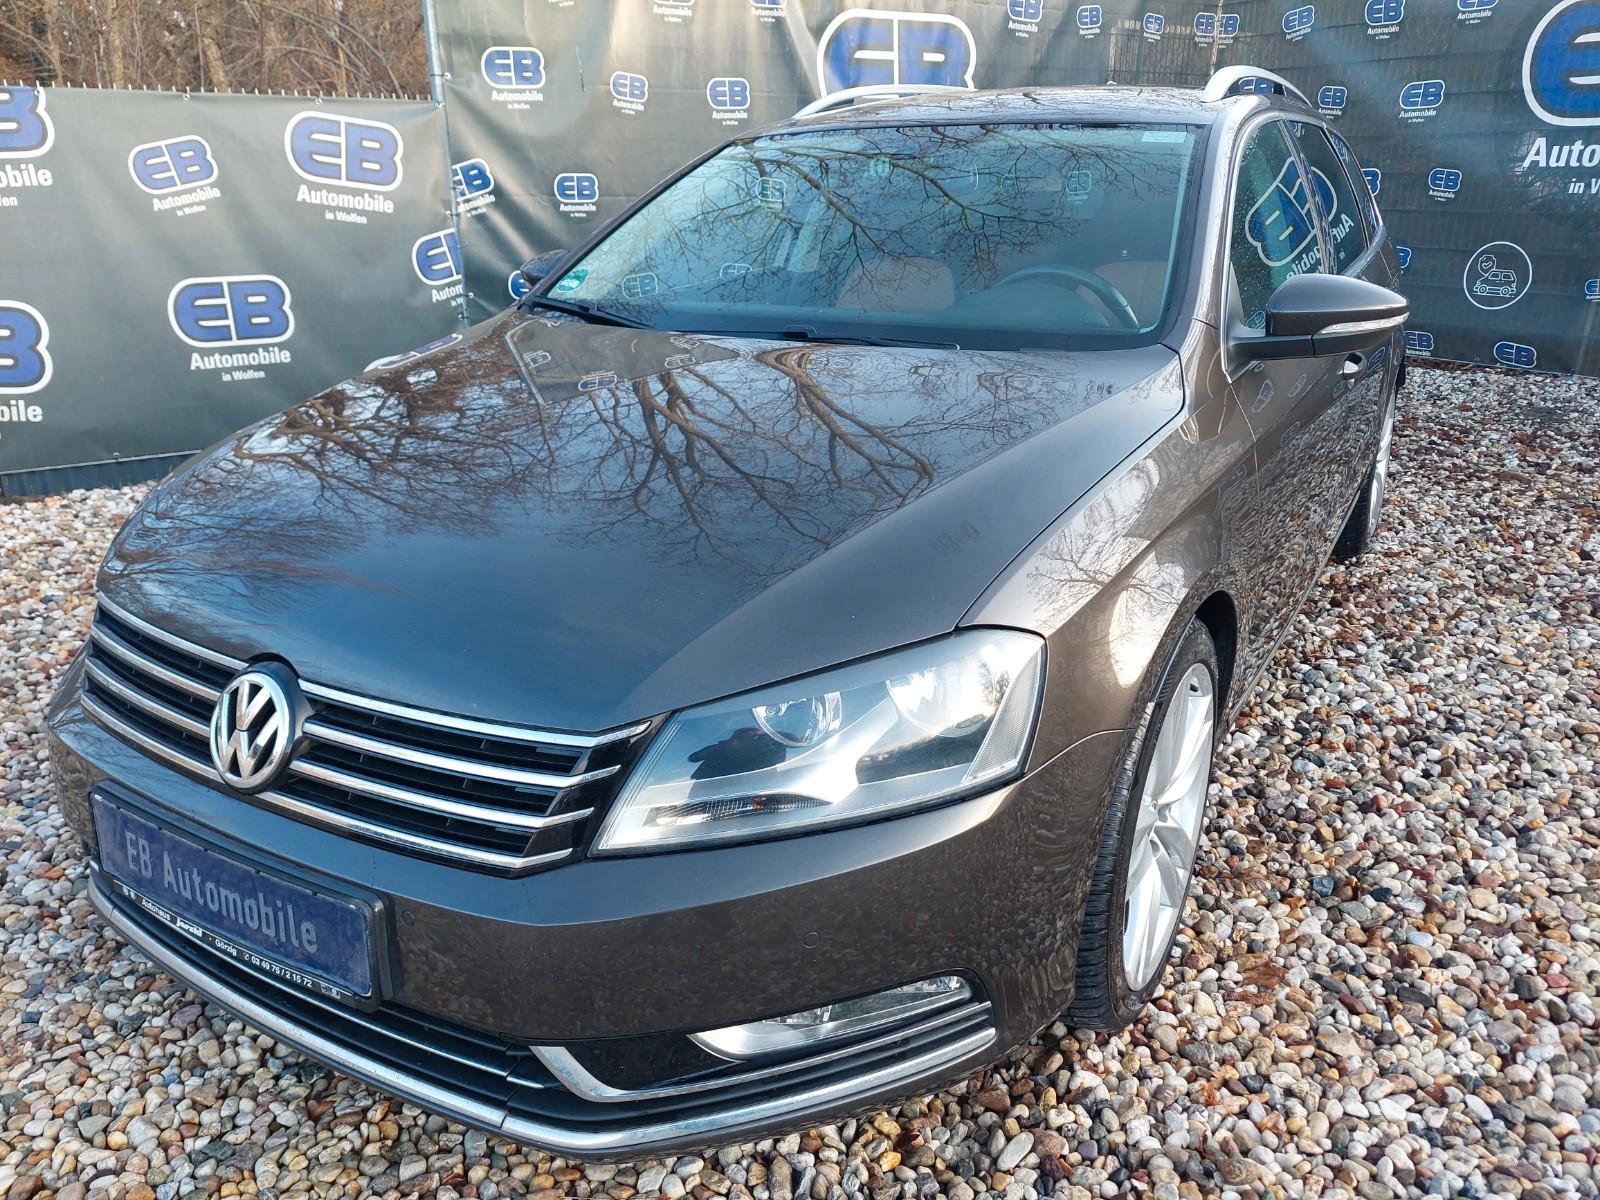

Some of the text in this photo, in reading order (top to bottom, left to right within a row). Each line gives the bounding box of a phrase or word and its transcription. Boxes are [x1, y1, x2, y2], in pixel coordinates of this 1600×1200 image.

[653, 5, 692, 17] Automobile
[752, 8, 786, 17] Automobile
[1076, 5, 1102, 29] EB
[1282, 5, 1314, 33] EB
[1365, 0, 1404, 26] EB
[1457, 9, 1493, 20] Automobile
[1008, 21, 1039, 33] Automobile
[1367, 25, 1400, 35] Automobile
[481, 47, 546, 89] EB
[491, 90, 543, 102] Automobile
[610, 71, 648, 102] EB
[707, 77, 750, 110] EB
[1318, 85, 1348, 108] EB
[1399, 79, 1446, 110] EB
[612, 98, 644, 112] Automobile
[712, 110, 748, 120] Automobile
[1399, 108, 1437, 119] Automobile
[284, 110, 404, 192] EB
[128, 134, 219, 195] EB
[554, 173, 599, 203] EB
[1428, 167, 1462, 191] EB
[1568, 178, 1585, 194] in
[152, 185, 221, 212] Automobile
[296, 184, 394, 214] Automobile
[559, 203, 597, 212] Automobile
[325, 209, 368, 225] in Wolfen
[167, 274, 296, 348] EB
[190, 347, 292, 371] Automobile
[1494, 341, 1537, 368] EB
[222, 370, 265, 381] in Wolfen
[124, 831, 319, 954] EB Automobile
[141, 897, 171, 921] Autohaus
[251, 955, 260, 966] 03
[261, 960, 270, 970] 49
[271, 965, 280, 974] 75
[285, 970, 291, 979] 2
[292, 974, 302, 984] 15
[303, 977, 313, 987] 72
